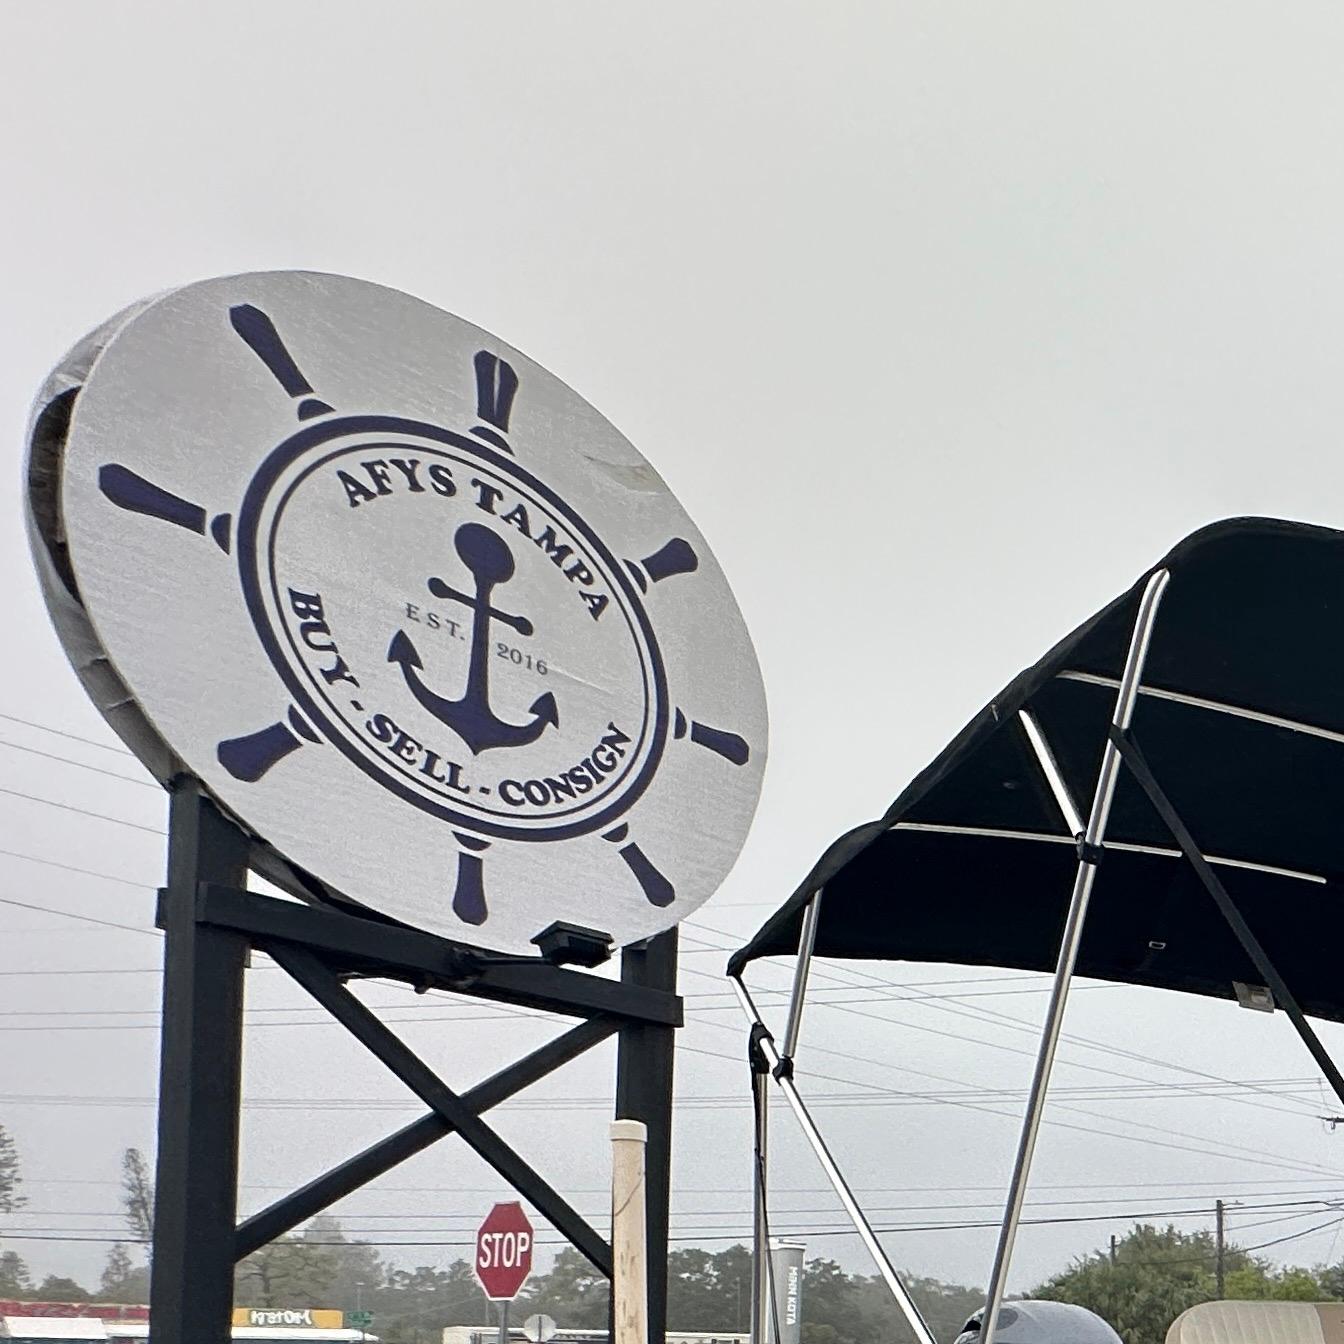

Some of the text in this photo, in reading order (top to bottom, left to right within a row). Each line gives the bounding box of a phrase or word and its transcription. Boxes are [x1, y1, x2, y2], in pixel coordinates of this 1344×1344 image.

[337, 458, 610, 622] AFYS TAMPA
[288, 586, 361, 689] BUY
[365, 713, 471, 795] SELL
[498, 721, 632, 807] CONSIGN
[405, 602, 549, 676] EST. 2016
[479, 1231, 531, 1269] STOP
